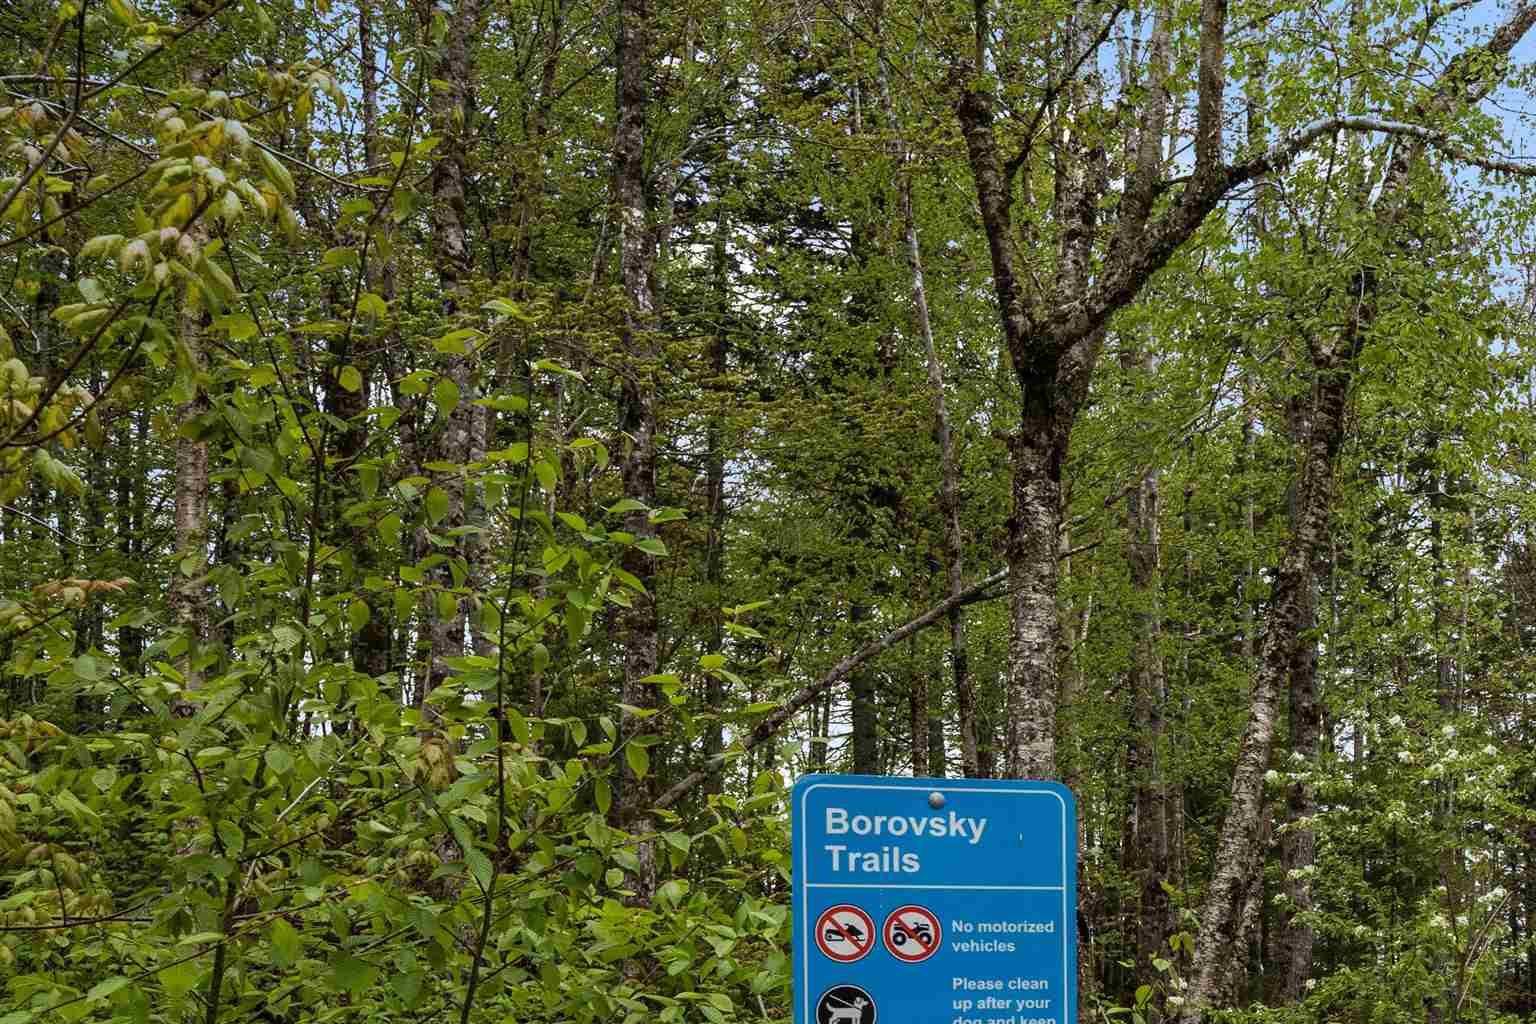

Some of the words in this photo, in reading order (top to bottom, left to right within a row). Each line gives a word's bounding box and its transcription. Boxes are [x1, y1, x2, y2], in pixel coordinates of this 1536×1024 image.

[825, 807, 987, 845] Borovsky
[825, 845, 921, 873] Trails
[952, 919, 974, 933] No
[978, 919, 1055, 933] motorized
[952, 939, 1016, 953] vehicles
[952, 977, 1004, 991] Please
[1008, 977, 1049, 991] clean
[952, 999, 973, 1013] up
[977, 996, 1012, 1010] after
[1015, 999, 1051, 1013] your
